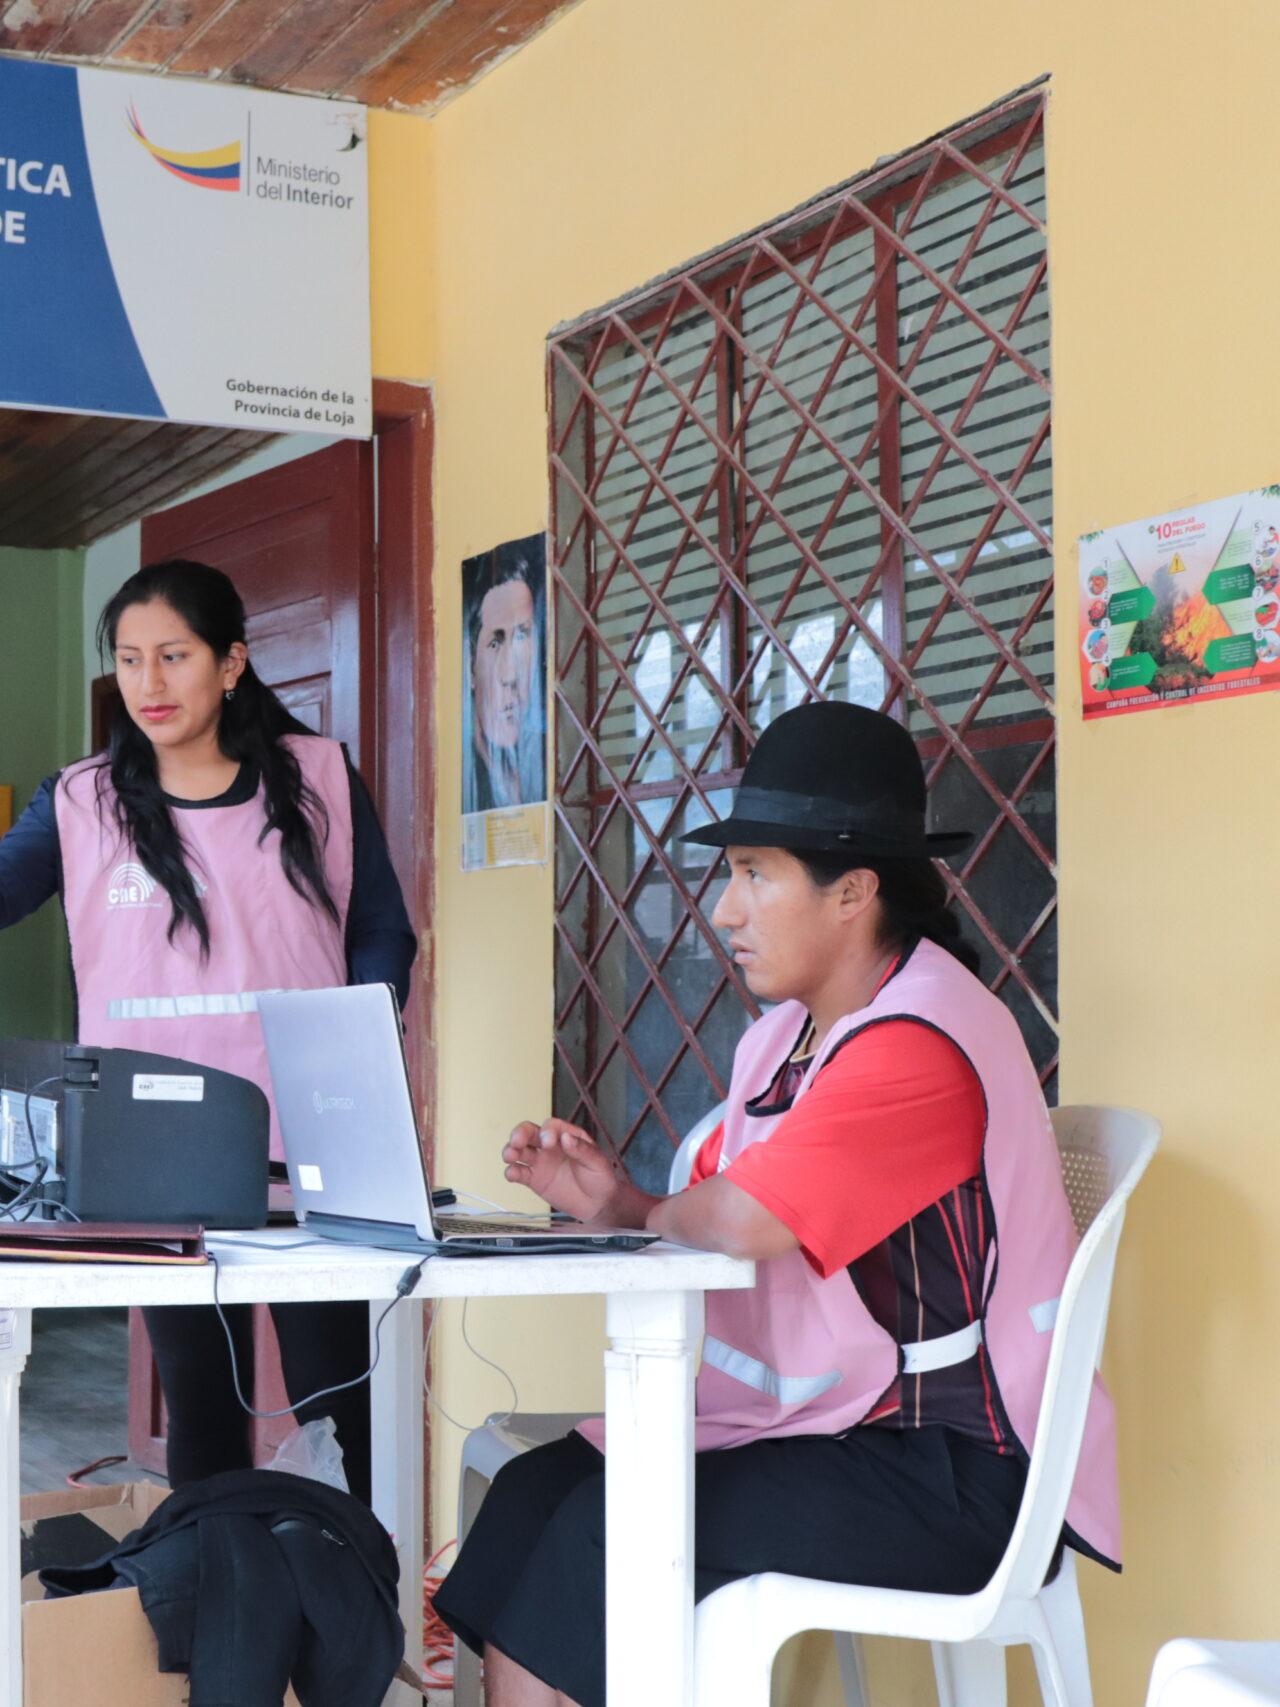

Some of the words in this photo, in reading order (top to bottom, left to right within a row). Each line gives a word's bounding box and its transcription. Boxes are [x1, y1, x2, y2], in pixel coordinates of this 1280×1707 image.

[256, 156, 341, 186] Ministerio
[256, 180, 283, 201] del
[286, 183, 355, 210] Interior
[225, 378, 318, 401] Gobernación
[321, 389, 339, 403] de
[342, 391, 355, 405] la
[234, 399, 301, 419] Provincia
[304, 406, 322, 421] de
[325, 409, 355, 427] Loja
[1156, 522, 1172, 541] 10
